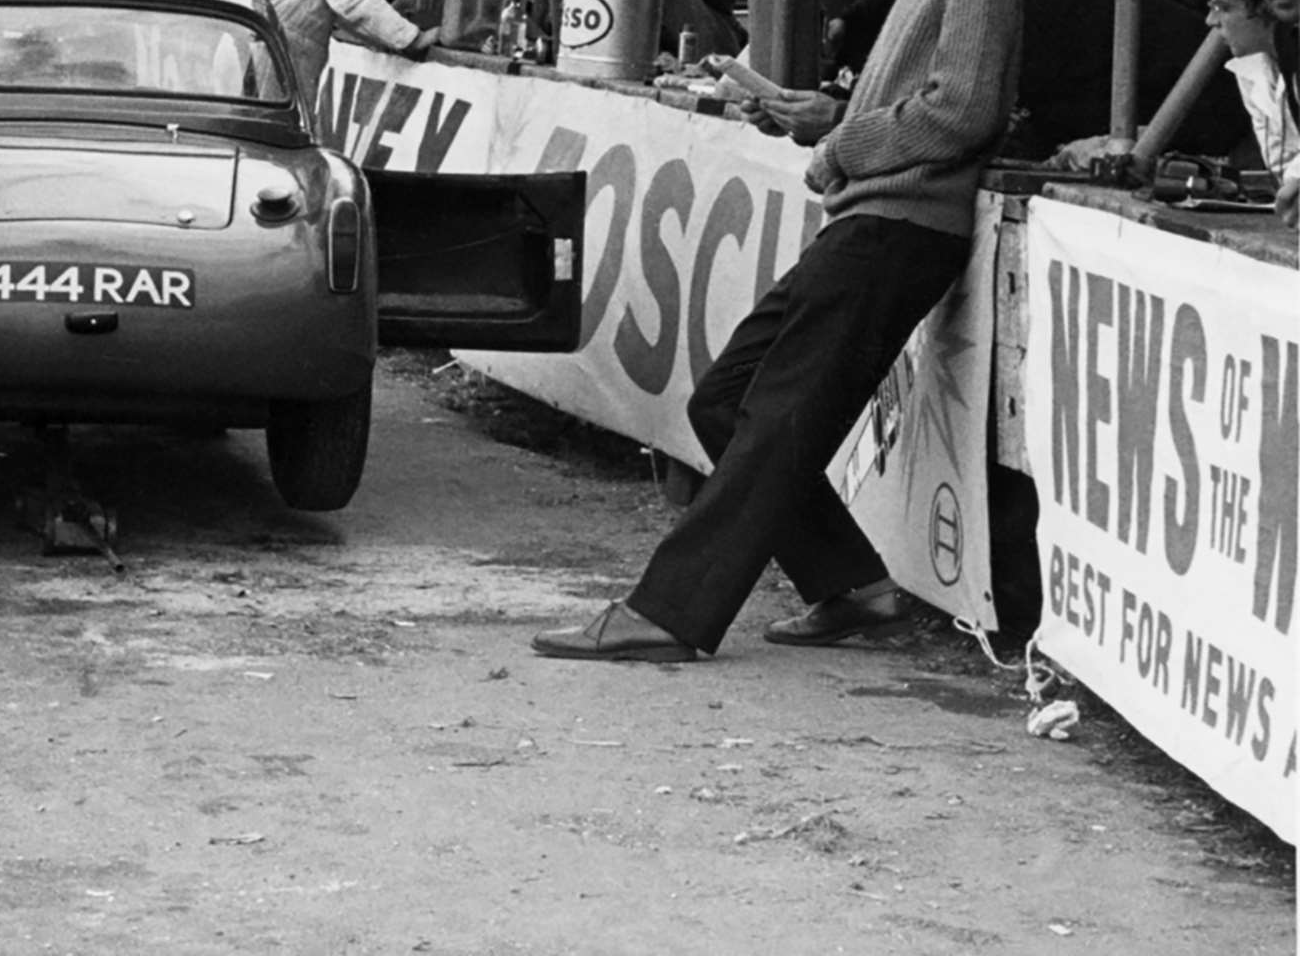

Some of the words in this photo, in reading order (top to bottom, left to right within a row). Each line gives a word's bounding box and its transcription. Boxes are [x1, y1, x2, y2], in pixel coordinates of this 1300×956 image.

[93, 267, 192, 307] RAR
[1048, 258, 1207, 576] NEWS
[1220, 353, 1252, 443] OF
[1210, 464, 1251, 564] THE
[1049, 544, 1111, 646] BEST
[1120, 588, 1172, 695] FOR
[1181, 629, 1275, 762] NEWS
